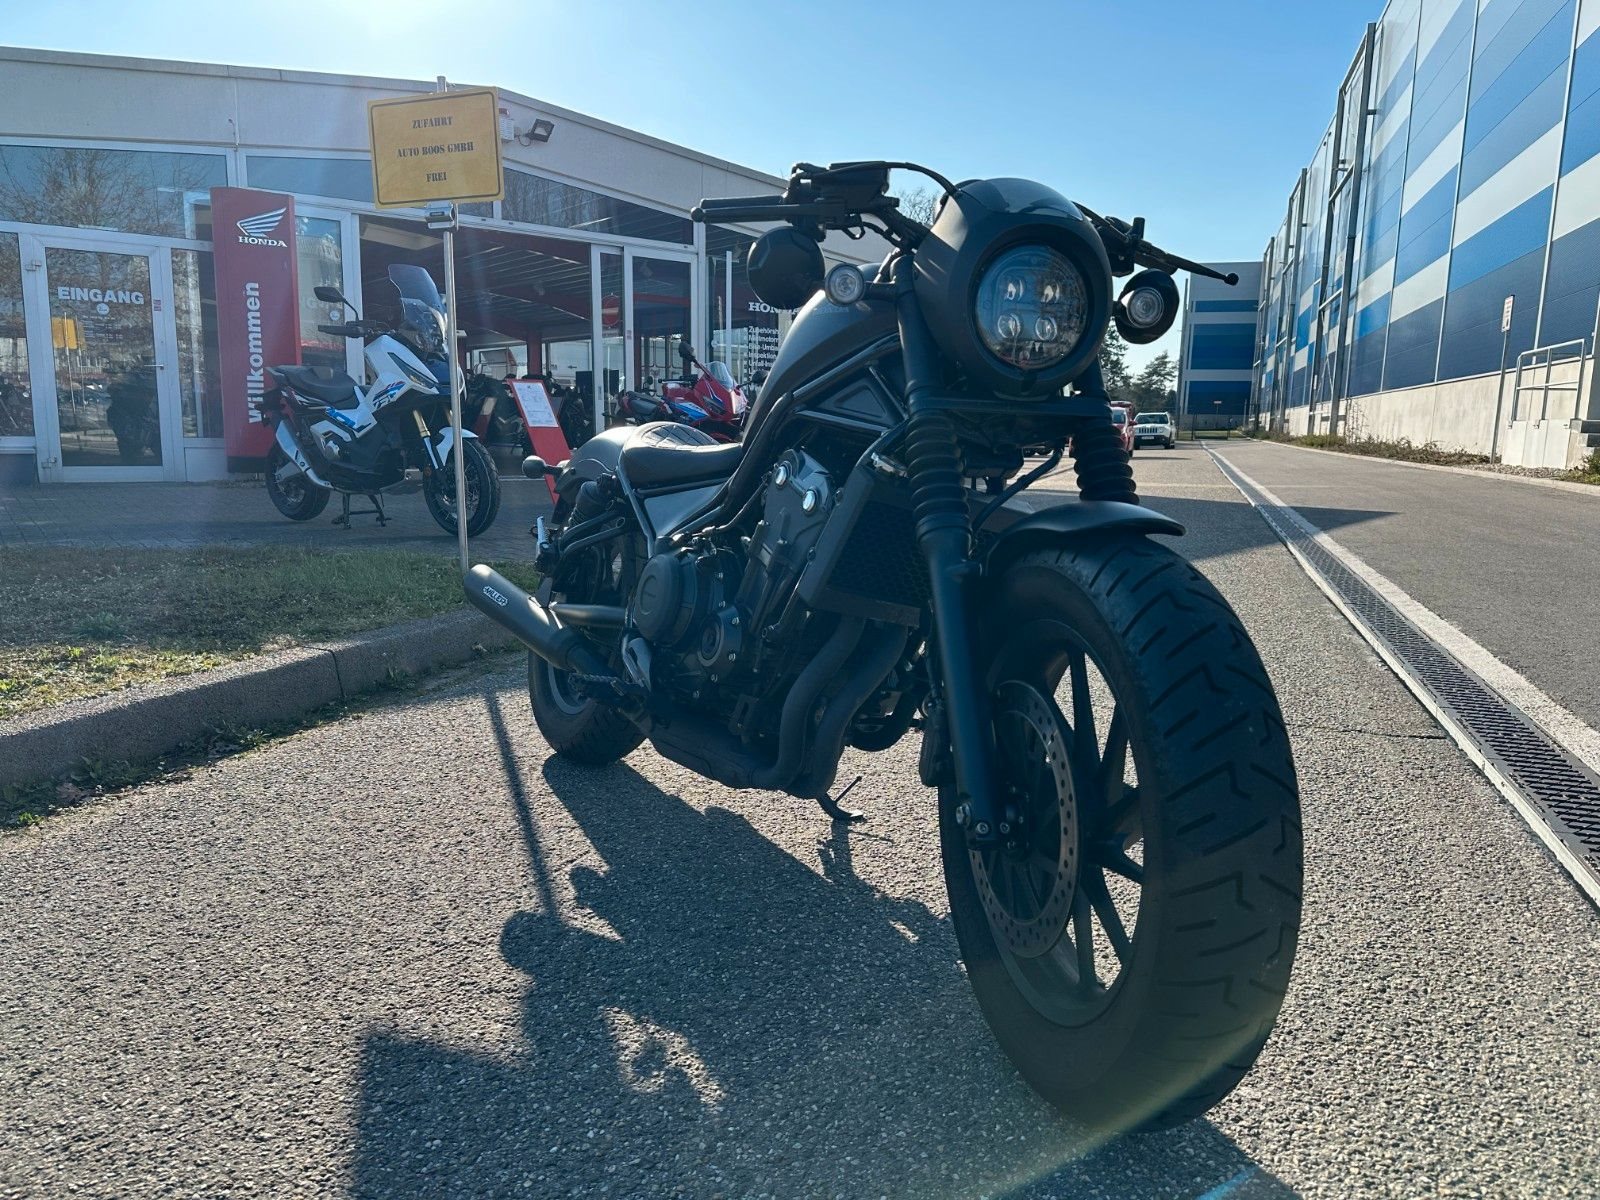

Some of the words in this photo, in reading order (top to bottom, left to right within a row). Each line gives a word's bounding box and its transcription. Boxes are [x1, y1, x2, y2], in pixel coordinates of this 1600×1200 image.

[412, 116, 453, 129] ZUFAHRT
[397, 147, 420, 158] AUTO
[422, 144, 445, 156] BOOS
[447, 141, 474, 153] GMBH
[426, 171, 447, 182] FREI
[238, 236, 288, 248] HONDA
[57, 286, 145, 305] EINGANG
